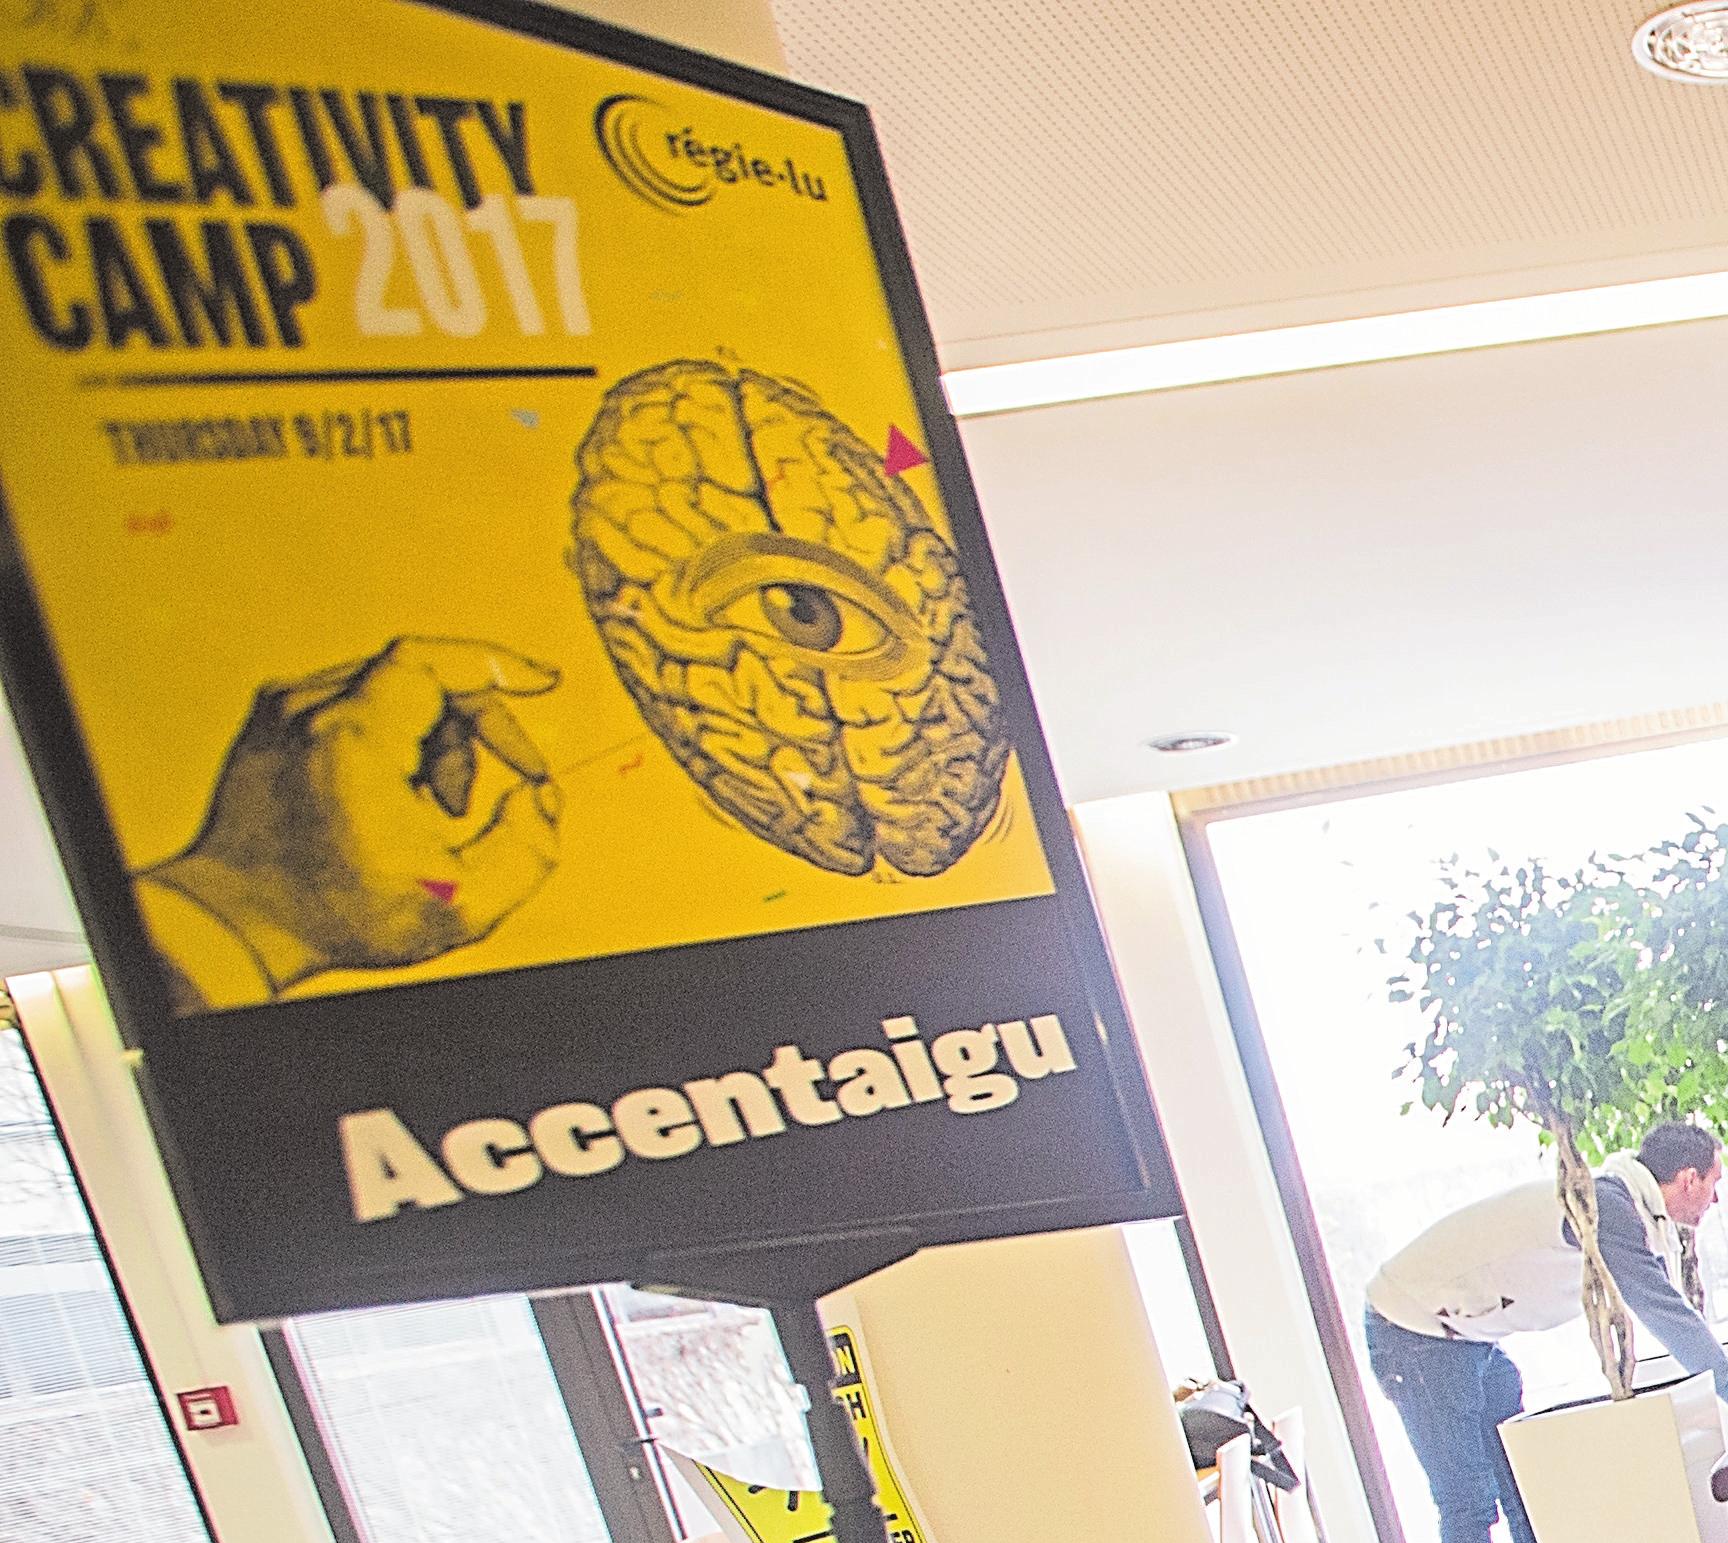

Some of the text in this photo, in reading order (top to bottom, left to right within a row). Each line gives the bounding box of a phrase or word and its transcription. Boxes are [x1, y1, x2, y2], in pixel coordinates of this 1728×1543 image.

[2, 182, 593, 351] CAMP 2017
[340, 1013, 1077, 1222] Accentaigu
